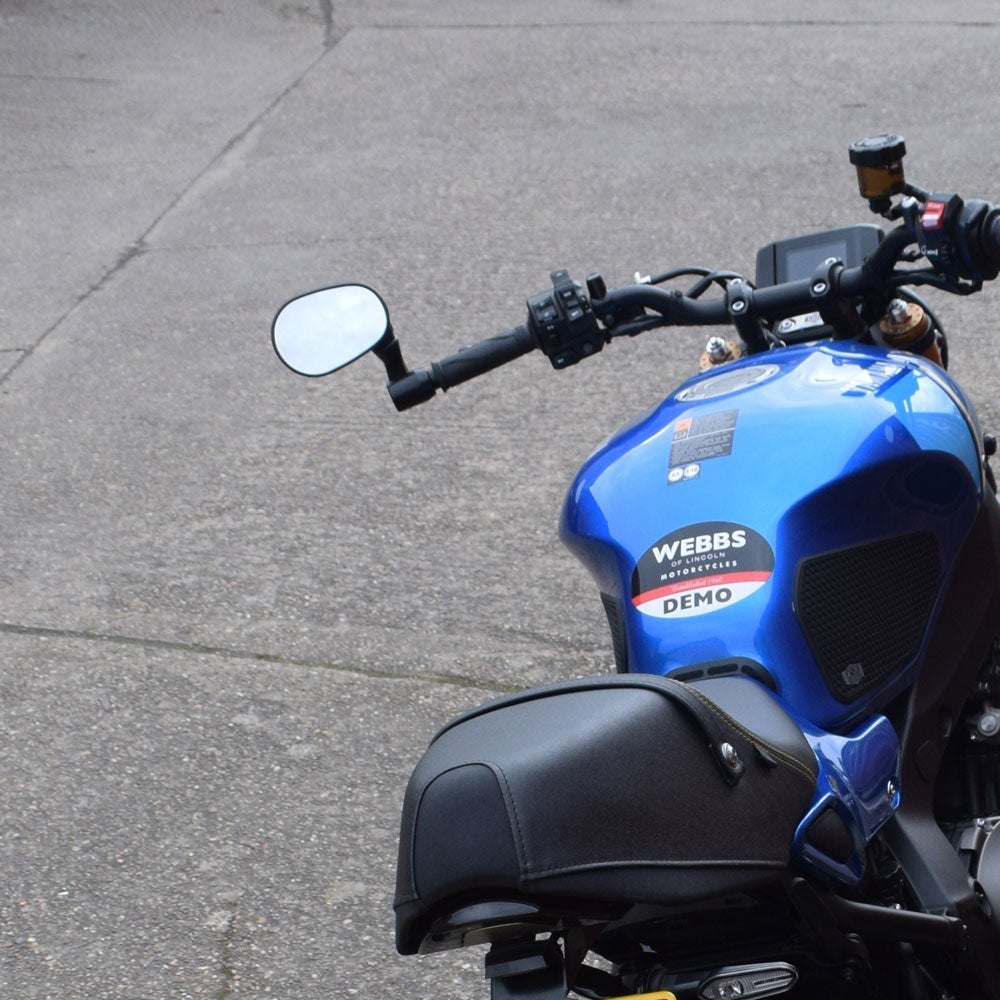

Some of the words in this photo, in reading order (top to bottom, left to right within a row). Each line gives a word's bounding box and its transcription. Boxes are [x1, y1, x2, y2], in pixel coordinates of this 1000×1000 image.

[652, 530, 747, 564] WEBBS
[660, 560, 738, 581] MOTORCYCLES
[671, 560, 683, 568] OF
[686, 552, 726, 565] LINCOLN
[663, 587, 733, 614] DEMO
